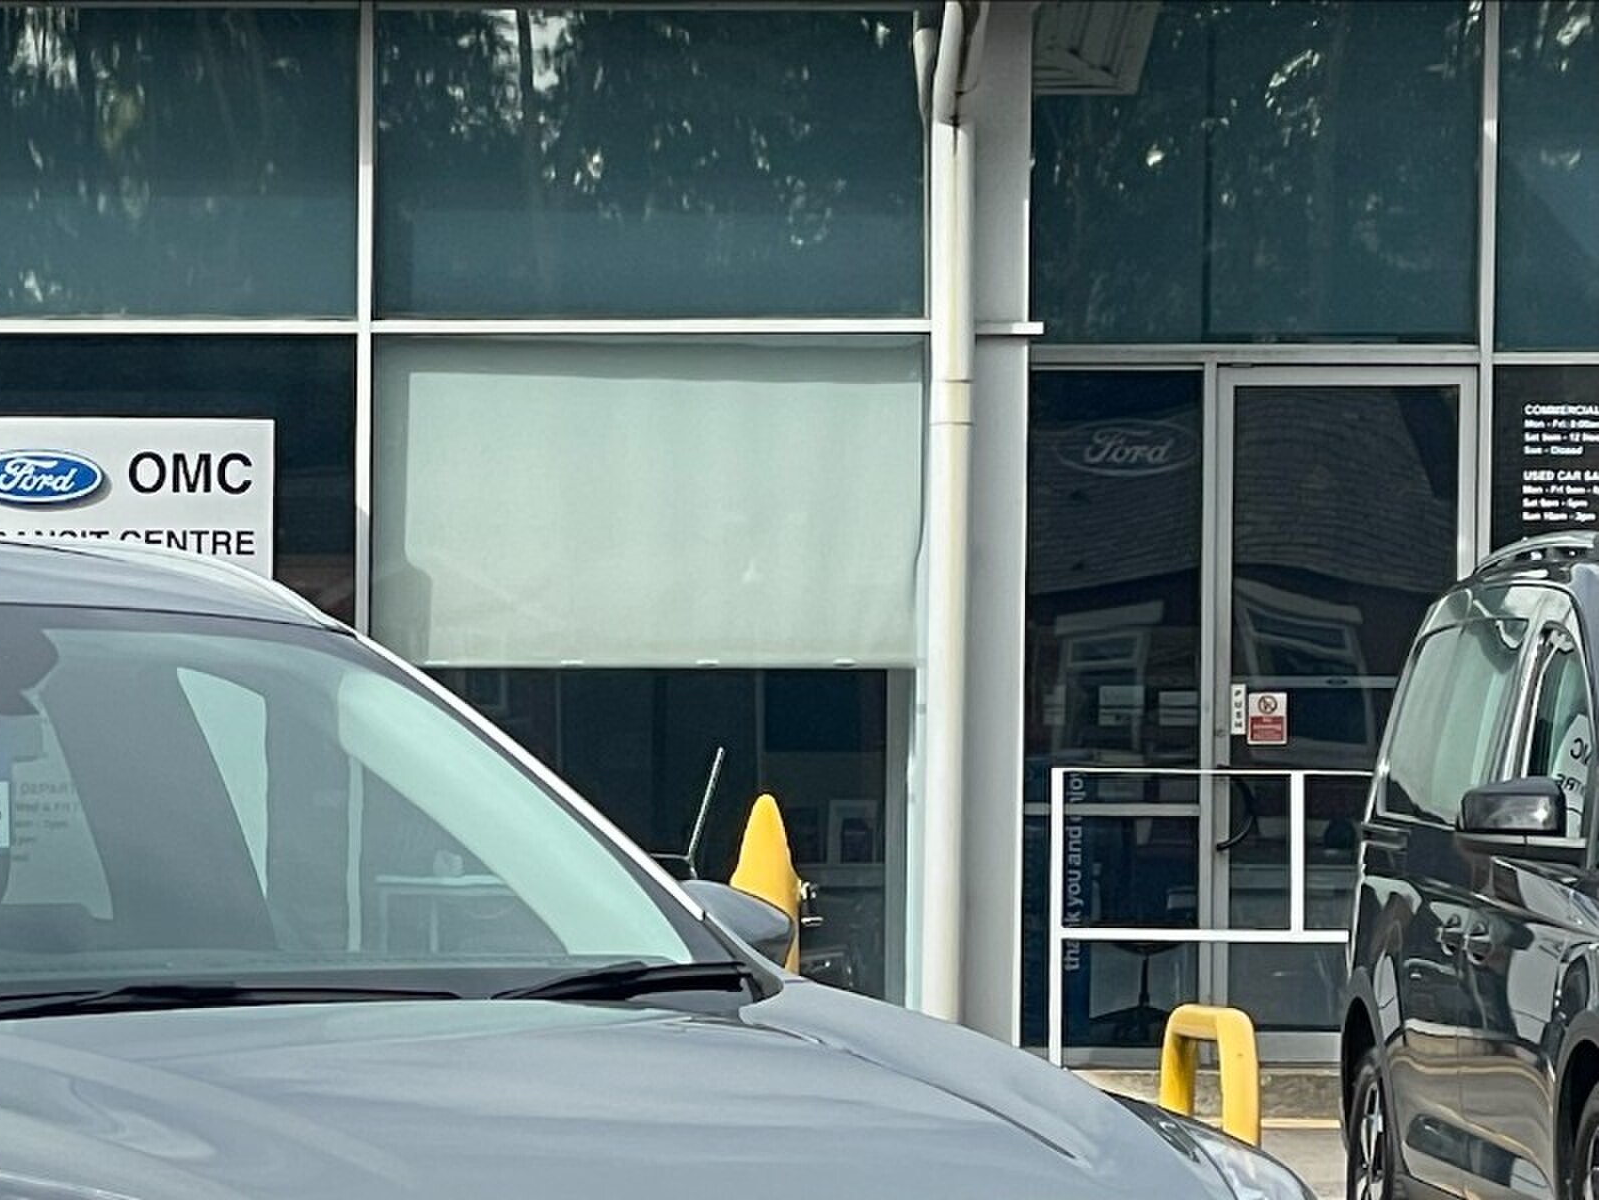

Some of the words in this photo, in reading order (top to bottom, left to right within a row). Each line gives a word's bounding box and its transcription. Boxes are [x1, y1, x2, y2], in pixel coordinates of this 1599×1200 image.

[1084, 427, 1174, 463] Ford
[128, 451, 252, 495] OMC
[1557, 470, 1581, 481] CAR
[1065, 825, 1082, 866] and
[1067, 870, 1084, 907] you
[1064, 911, 1081, 971] thak
